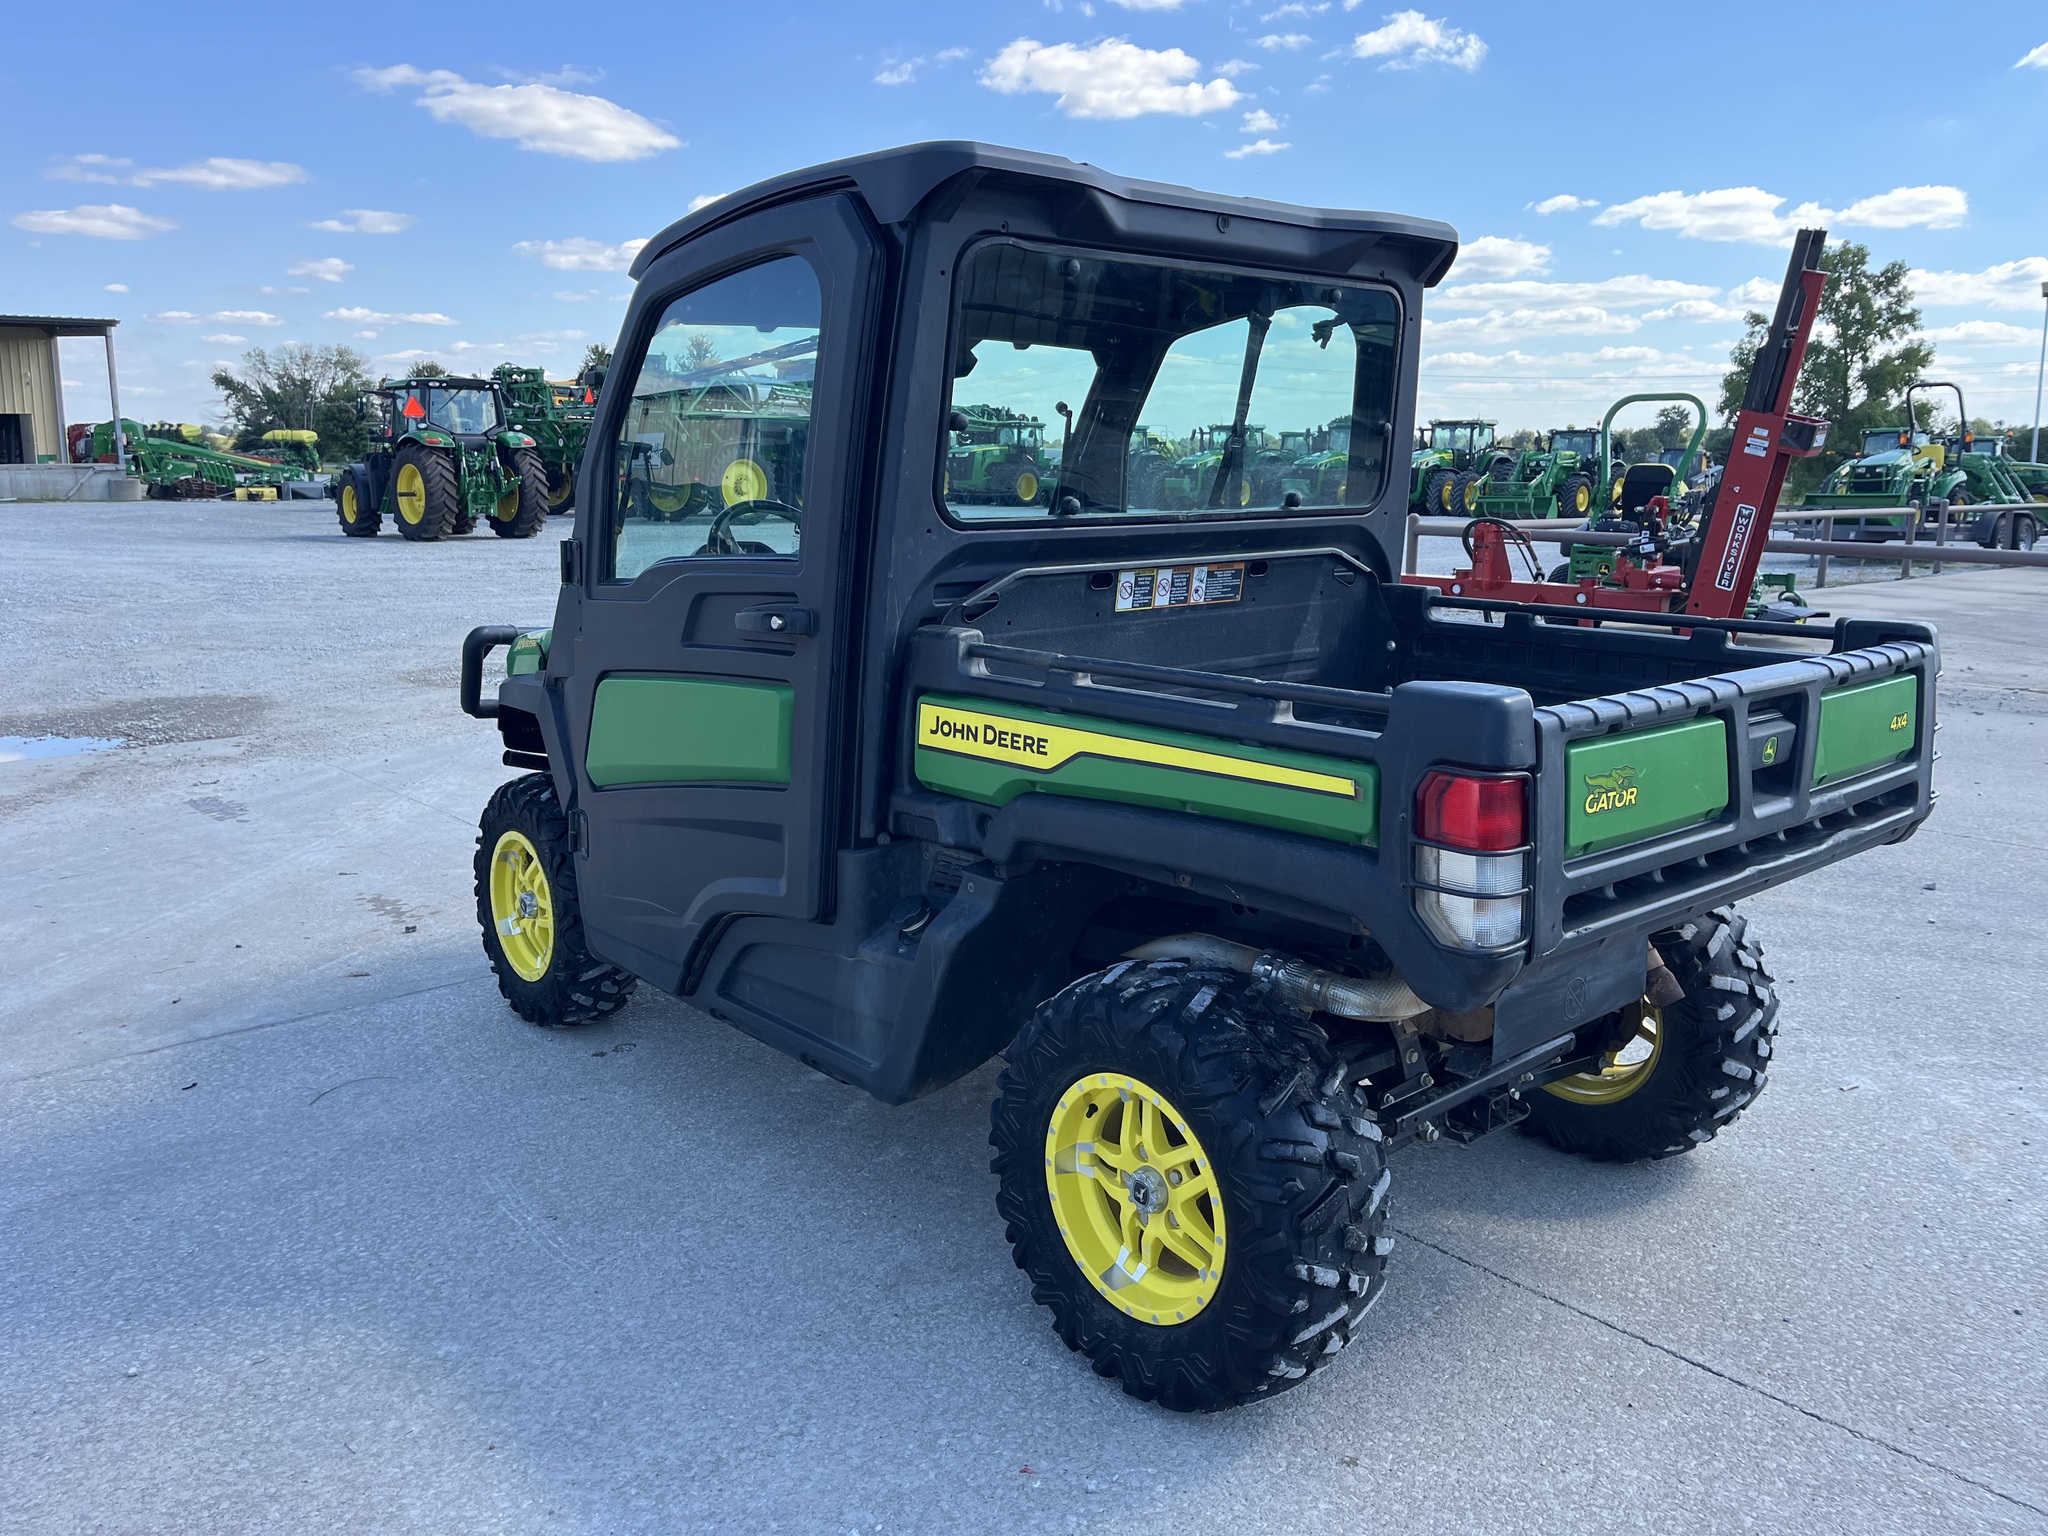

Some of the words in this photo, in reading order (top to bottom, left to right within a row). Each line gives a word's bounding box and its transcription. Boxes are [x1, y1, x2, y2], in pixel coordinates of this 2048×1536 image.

[1720, 516, 1749, 587] WORKSAVER
[930, 715, 978, 742] JOHN
[983, 724, 1048, 756] DEERE
[1585, 787, 1638, 814] GATOR
